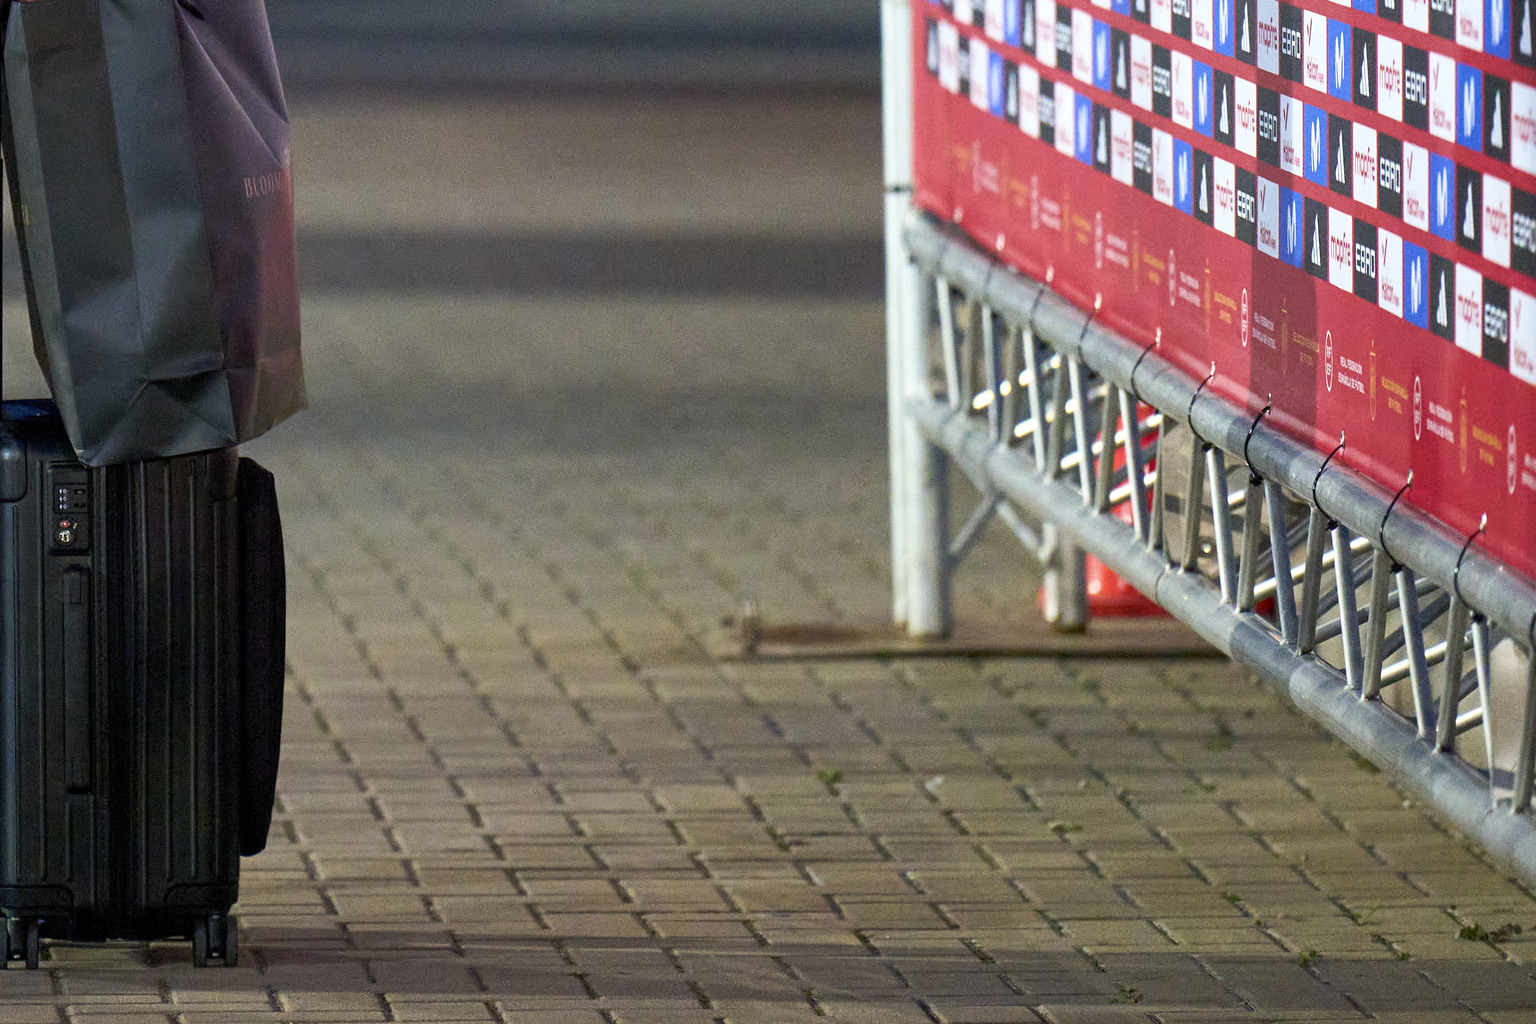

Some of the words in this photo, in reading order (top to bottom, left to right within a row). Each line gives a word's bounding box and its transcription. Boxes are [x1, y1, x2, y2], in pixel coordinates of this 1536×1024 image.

[1259, 16, 1276, 53] mapfre
[1281, 25, 1300, 59] EBRO
[1380, 58, 1400, 97] mapfre
[1405, 69, 1426, 105] EBRO
[1237, 99, 1254, 135] mapfre
[1259, 108, 1277, 143] EBRO
[1355, 146, 1374, 184] mapfre
[1379, 156, 1400, 193] EBRO
[1237, 189, 1254, 223] EBRO
[1331, 231, 1350, 268] mapfre
[1355, 241, 1375, 279] EBRO
